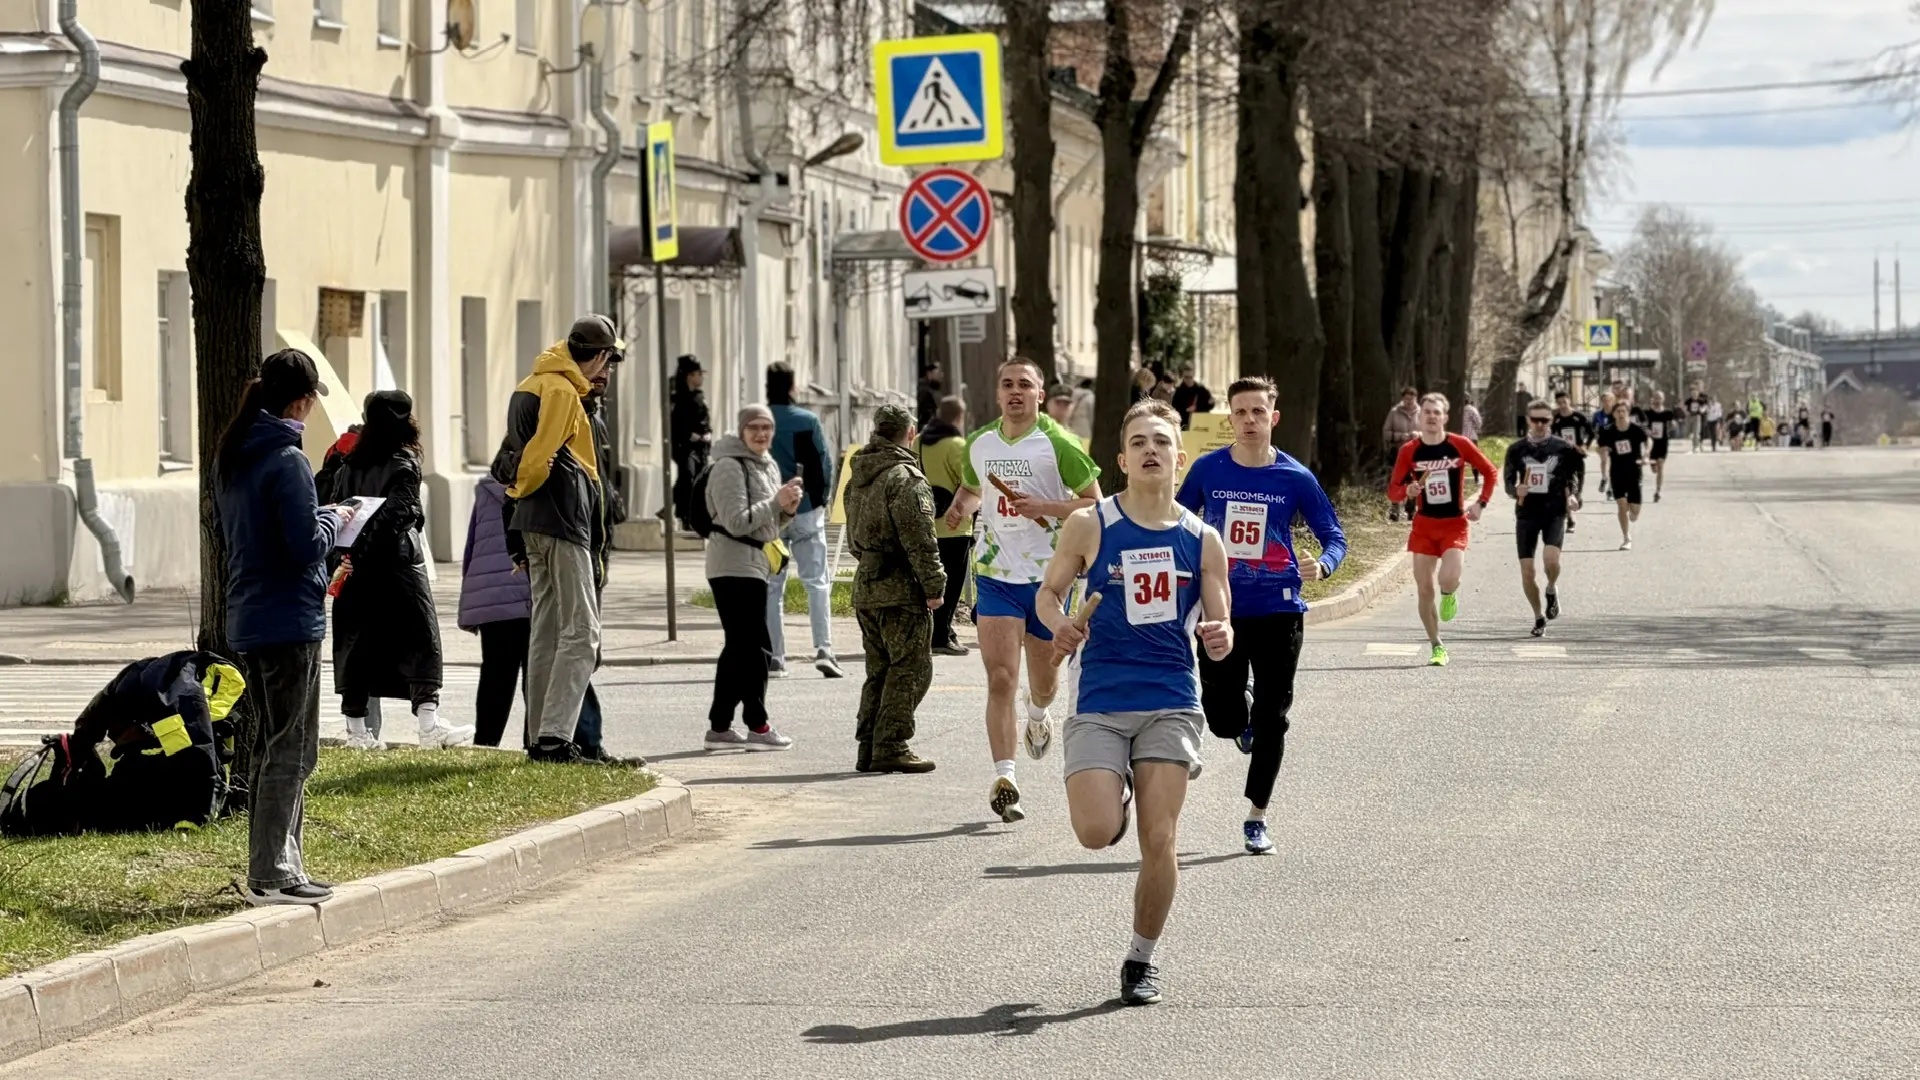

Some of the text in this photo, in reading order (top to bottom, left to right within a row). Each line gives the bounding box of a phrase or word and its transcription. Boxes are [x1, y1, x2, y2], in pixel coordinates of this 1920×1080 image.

[1531, 473, 1544, 486] 67
[1428, 482, 1447, 496] 55
[1212, 490, 1286, 504] СОВКОМБАНК
[1230, 520, 1260, 546] 65
[1133, 571, 1171, 605] 34
